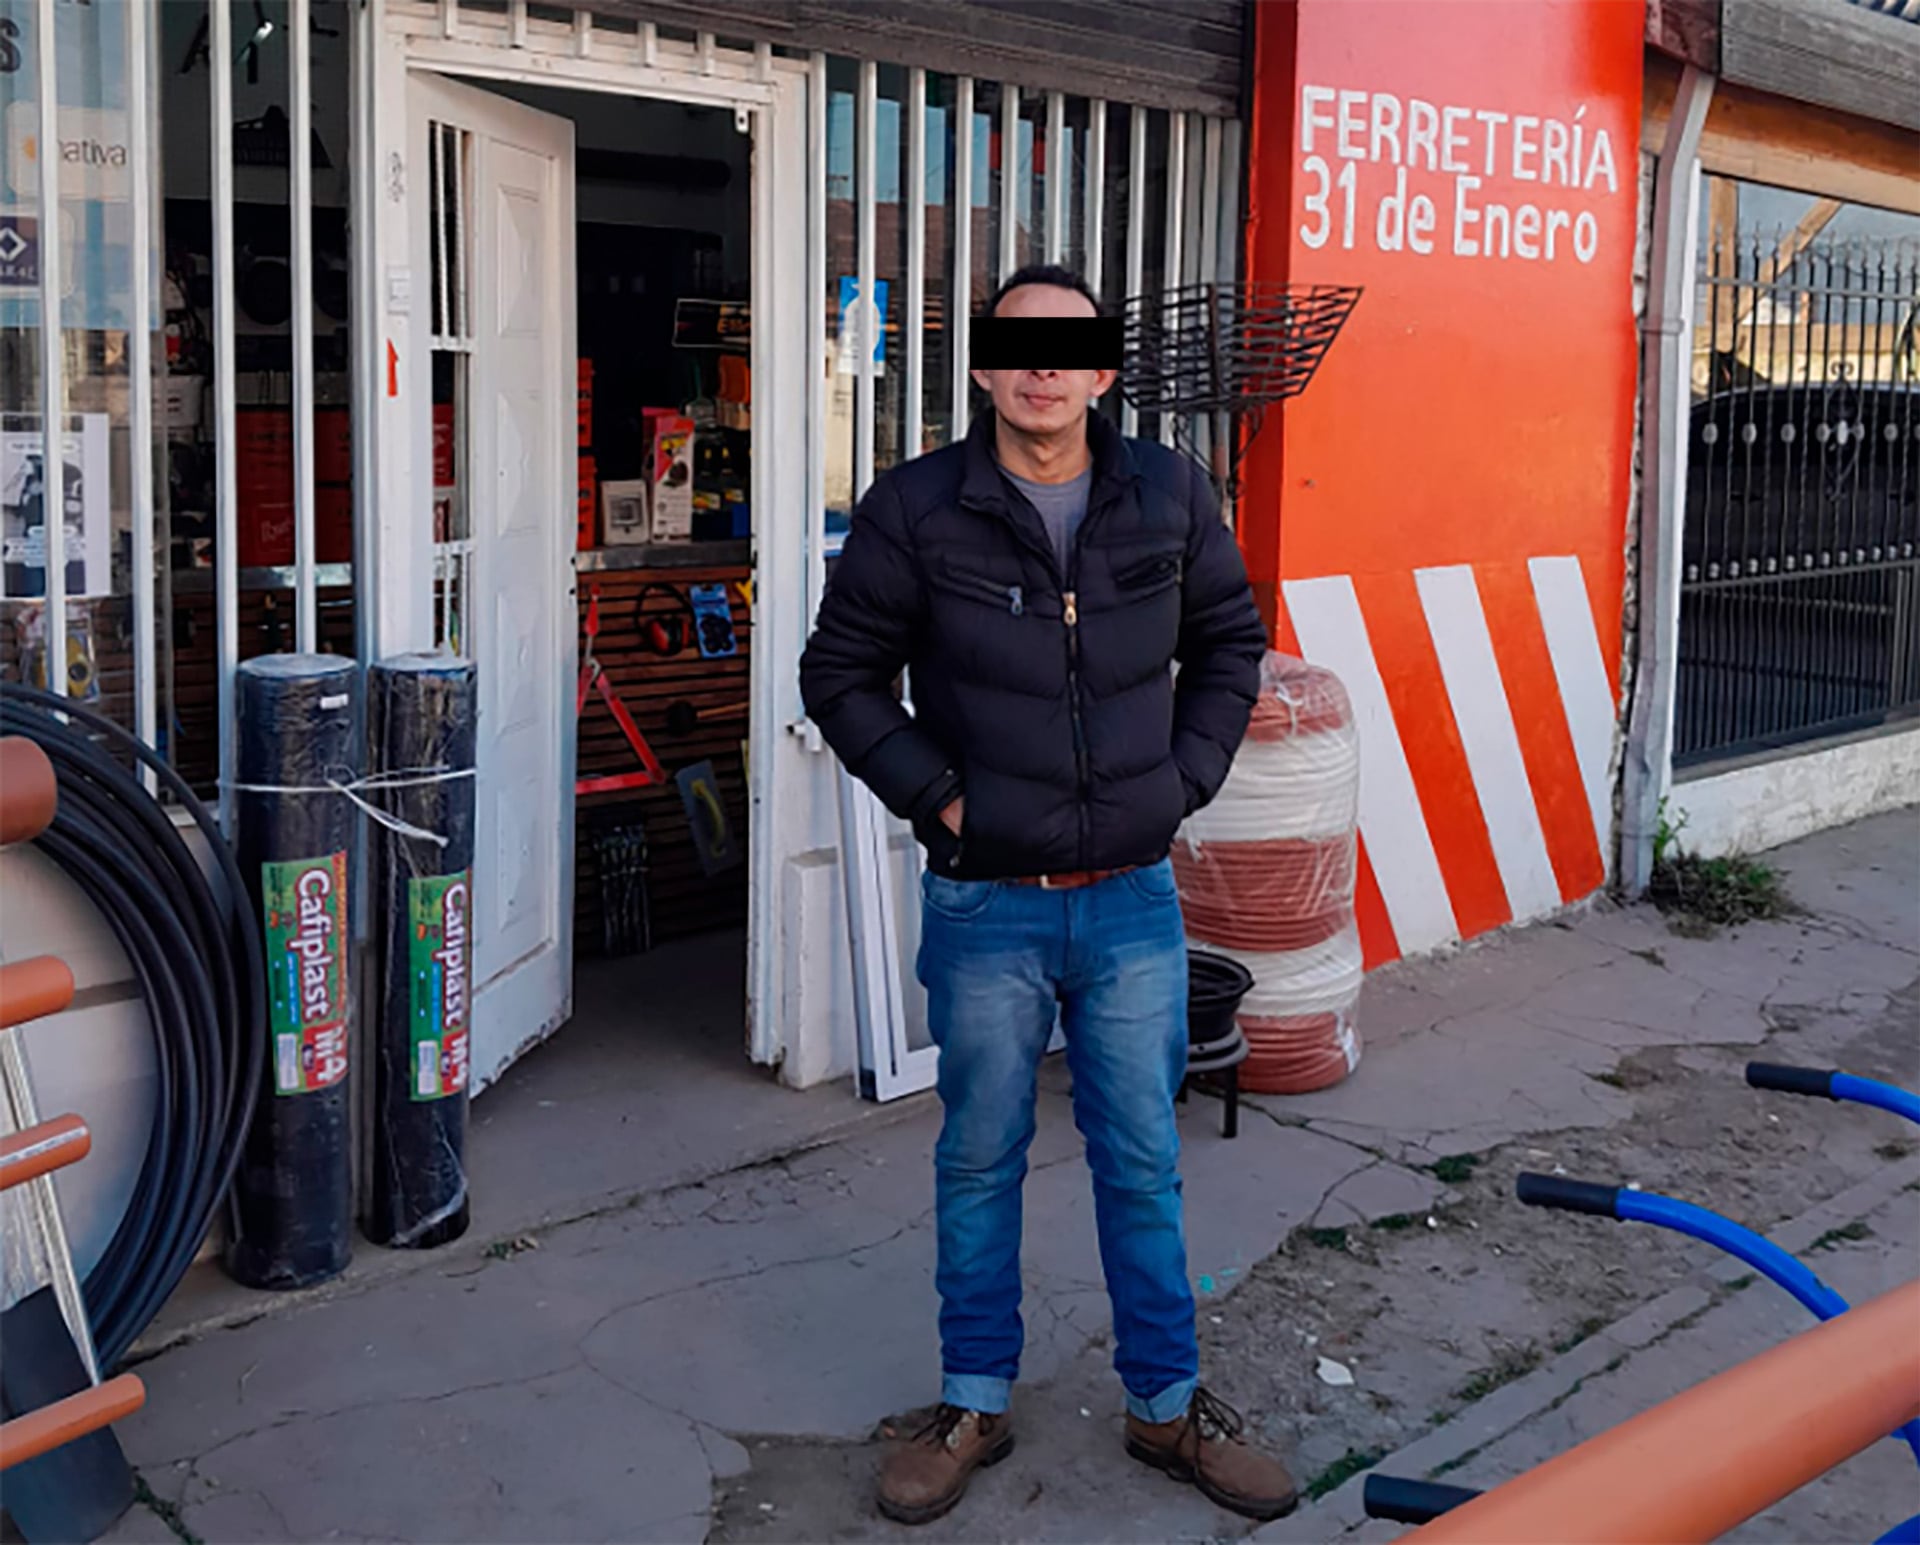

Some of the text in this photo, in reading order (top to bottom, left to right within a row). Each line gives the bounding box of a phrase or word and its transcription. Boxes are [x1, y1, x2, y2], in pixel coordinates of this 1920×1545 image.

[1300, 84, 1618, 193] FERRETERÍA
[1299, 156, 1599, 264] 31 de Enero
[289, 869, 331, 1019] Cafiplast
[434, 883, 468, 1027] Cafiplast
